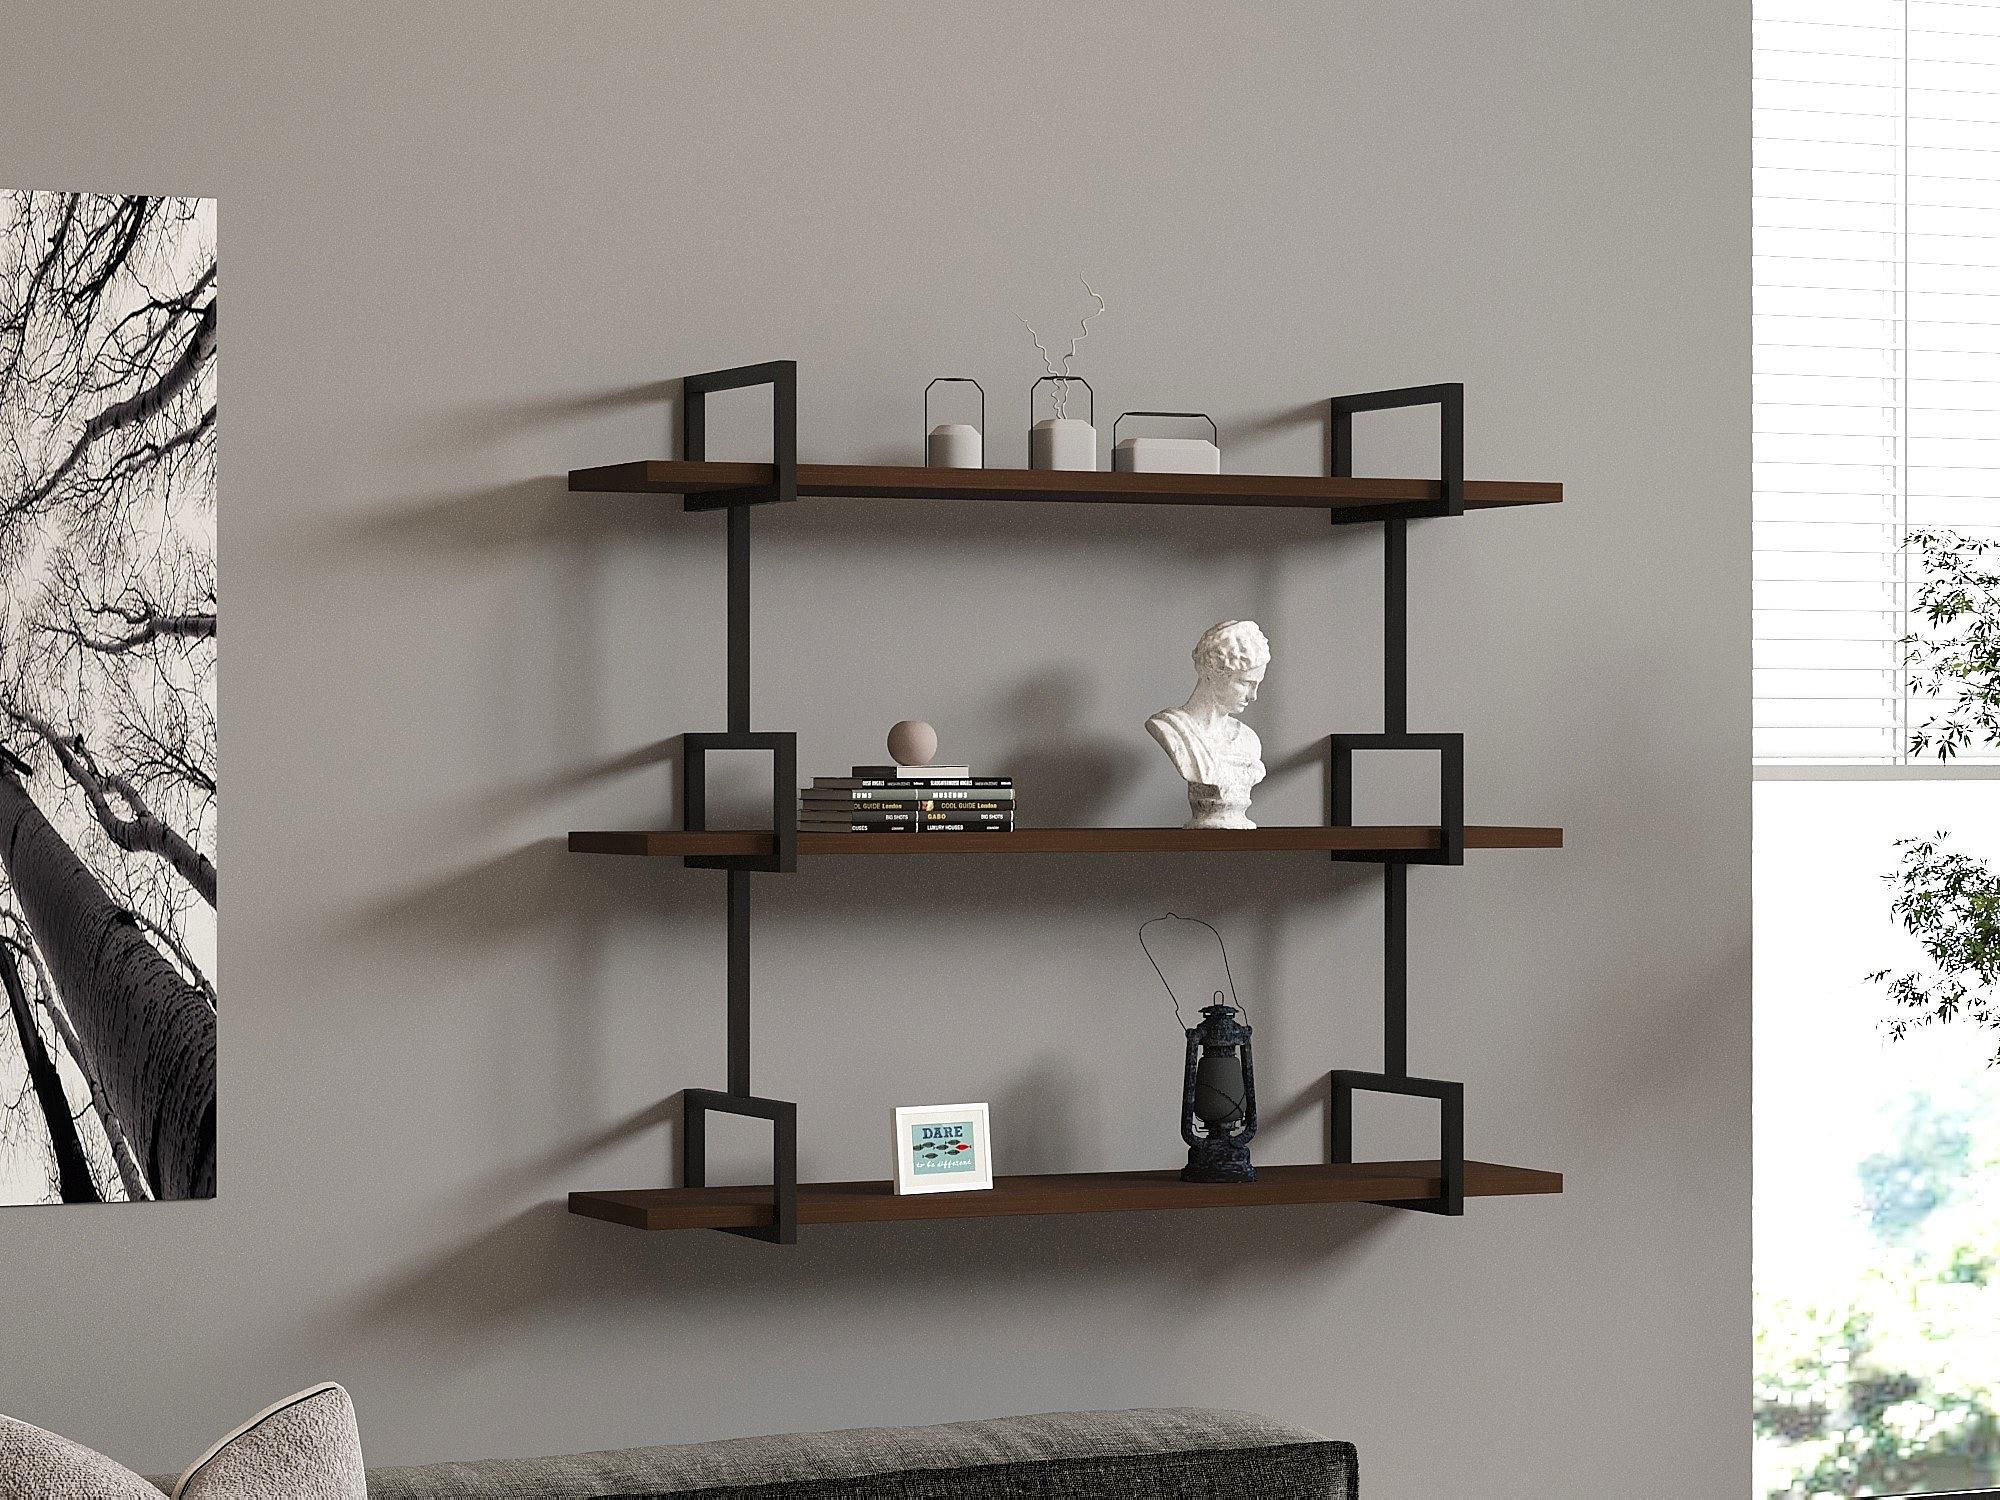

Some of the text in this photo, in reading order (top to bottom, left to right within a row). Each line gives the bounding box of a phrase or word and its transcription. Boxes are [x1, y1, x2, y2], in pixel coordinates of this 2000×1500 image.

[922, 1126, 963, 1139] DARE
[927, 1160, 936, 1168] be
[937, 1159, 972, 1169] different
